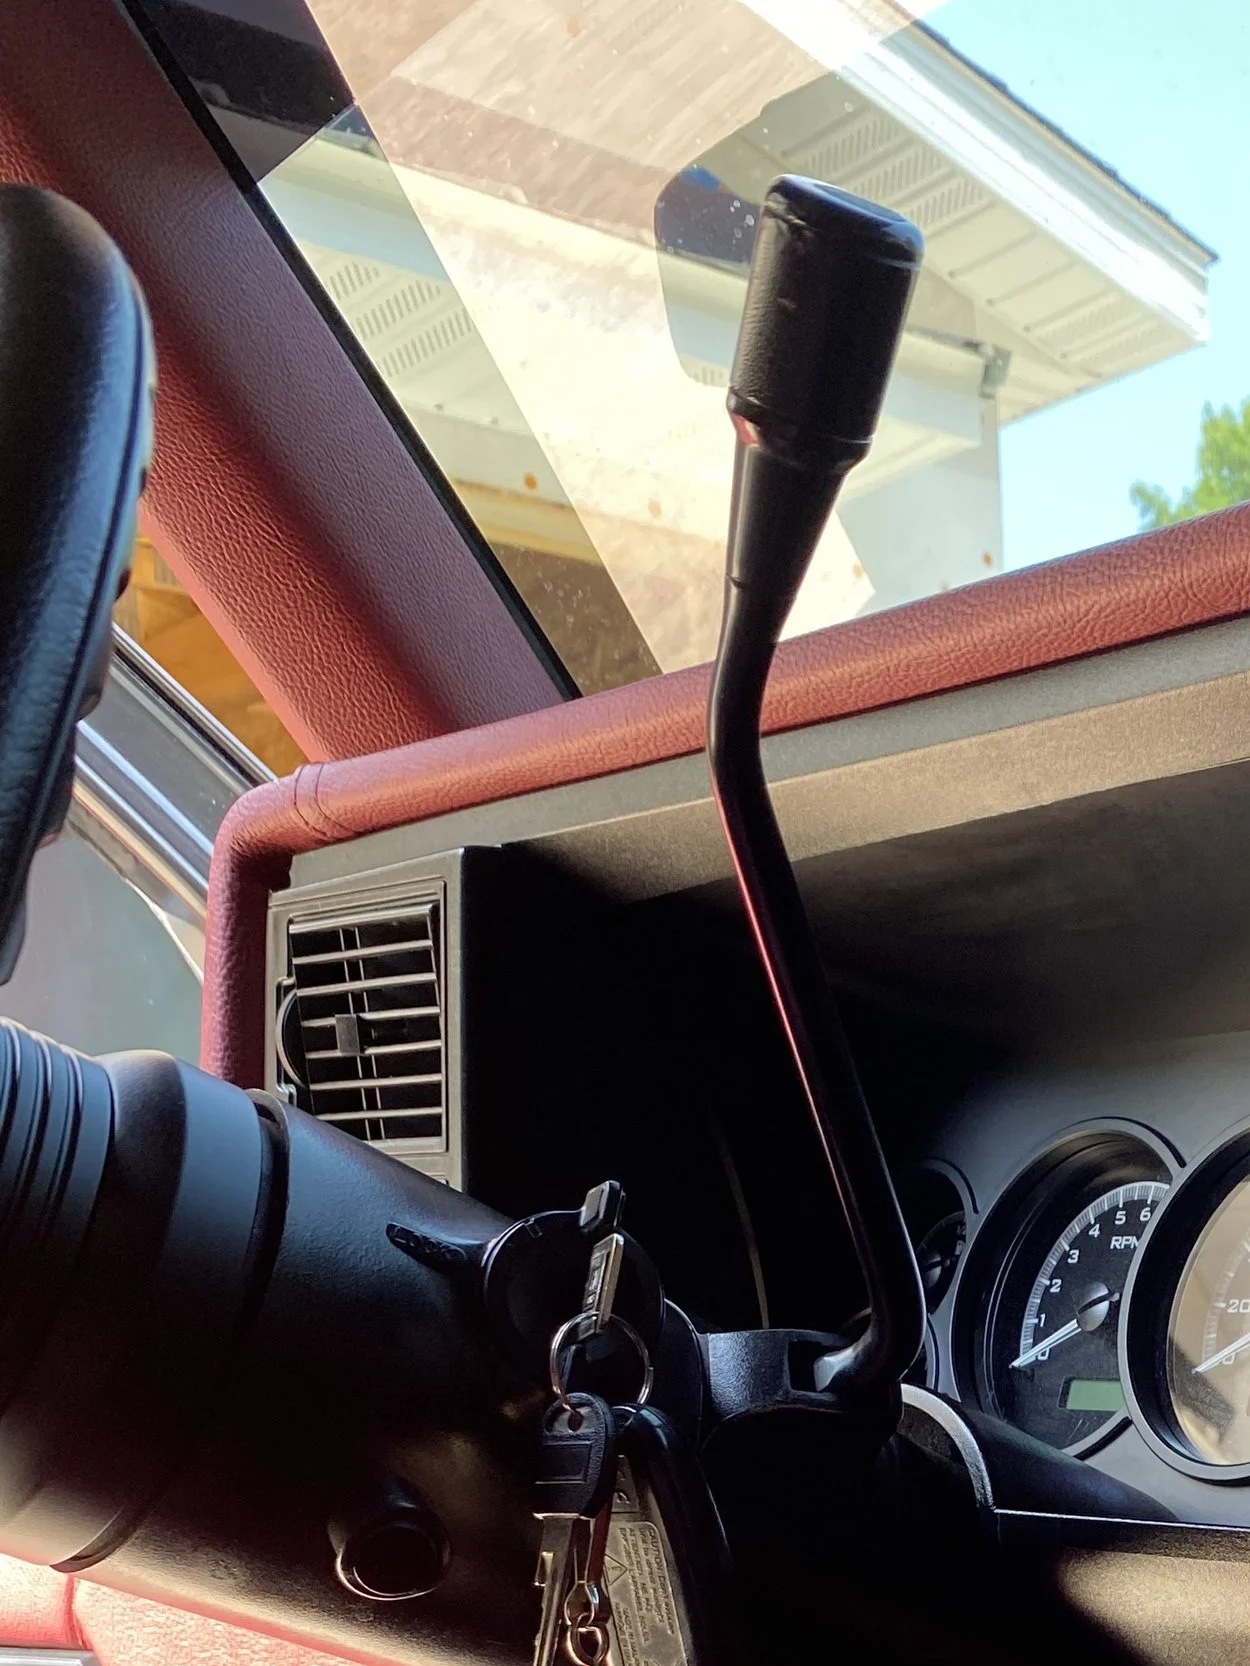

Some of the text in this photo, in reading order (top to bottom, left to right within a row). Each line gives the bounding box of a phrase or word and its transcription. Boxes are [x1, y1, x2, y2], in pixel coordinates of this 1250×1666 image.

[1114, 1210, 1127, 1225] 5
[1140, 1206, 1151, 1222] 6
[1088, 1223, 1100, 1238] 4
[1067, 1249, 1080, 1265] 3
[1049, 1279, 1062, 1294] 2
[1039, 1313, 1046, 1328] 1
